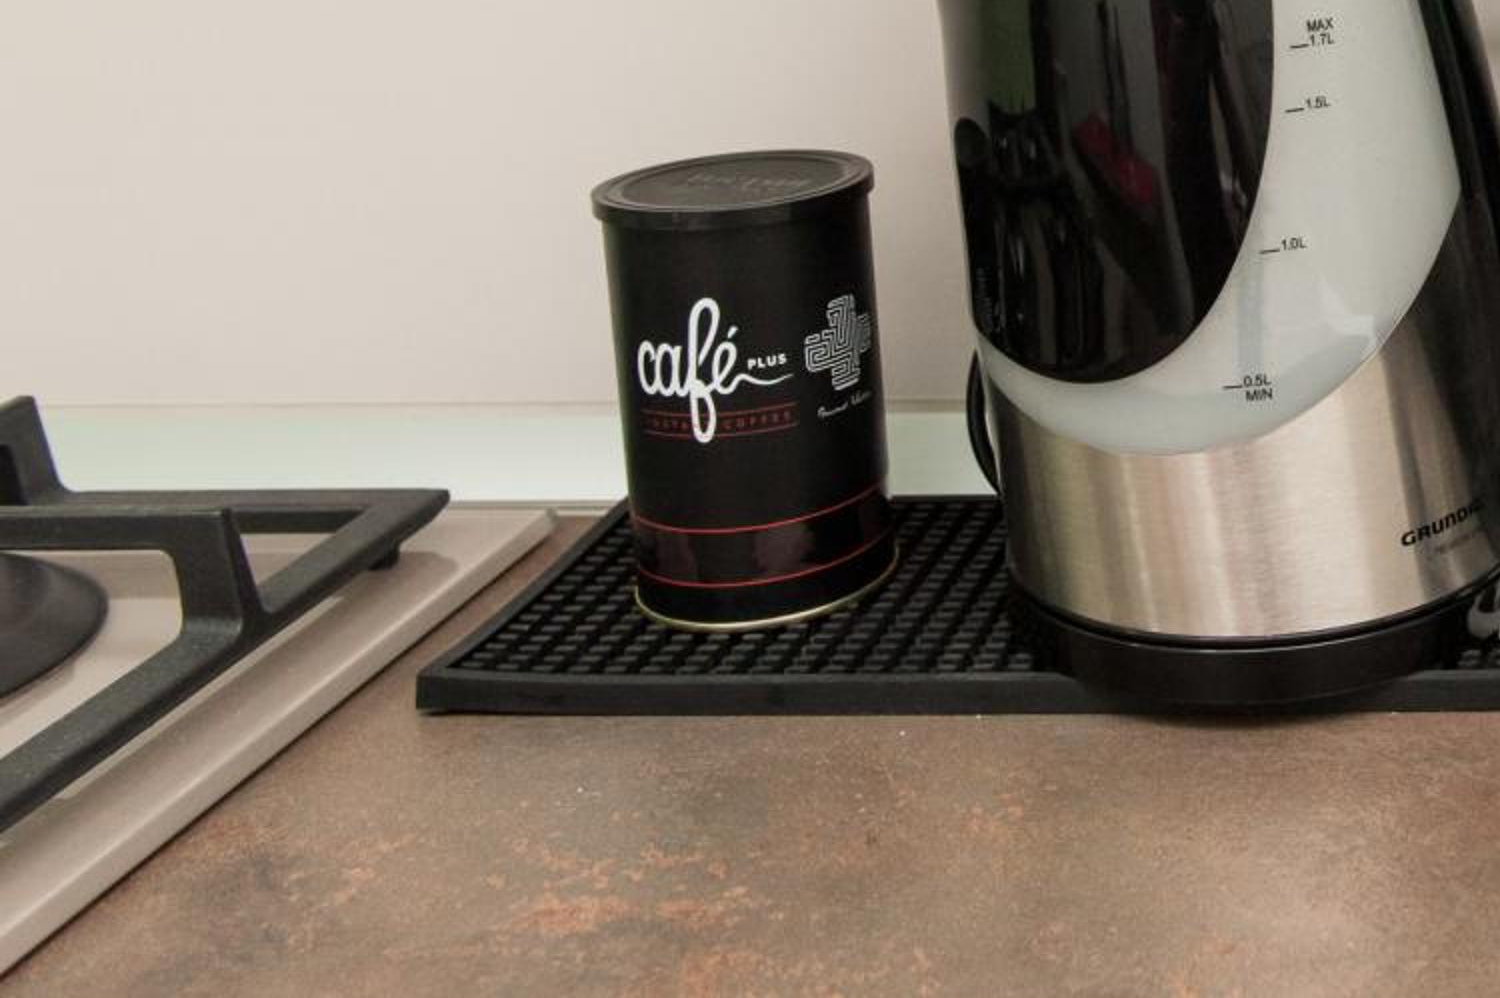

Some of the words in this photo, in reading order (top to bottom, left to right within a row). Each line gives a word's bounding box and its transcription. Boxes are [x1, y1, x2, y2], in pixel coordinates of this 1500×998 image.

[1306, 17, 1335, 33] MAX
[1309, 33, 1335, 47] 1.7L
[1305, 96, 1331, 109] 1.5L
[1281, 237, 1307, 251] 1.0L
[637, 297, 793, 444] café
[746, 352, 788, 370] PLUS
[1243, 373, 1272, 388] 0.5L
[1245, 388, 1274, 402] MIN
